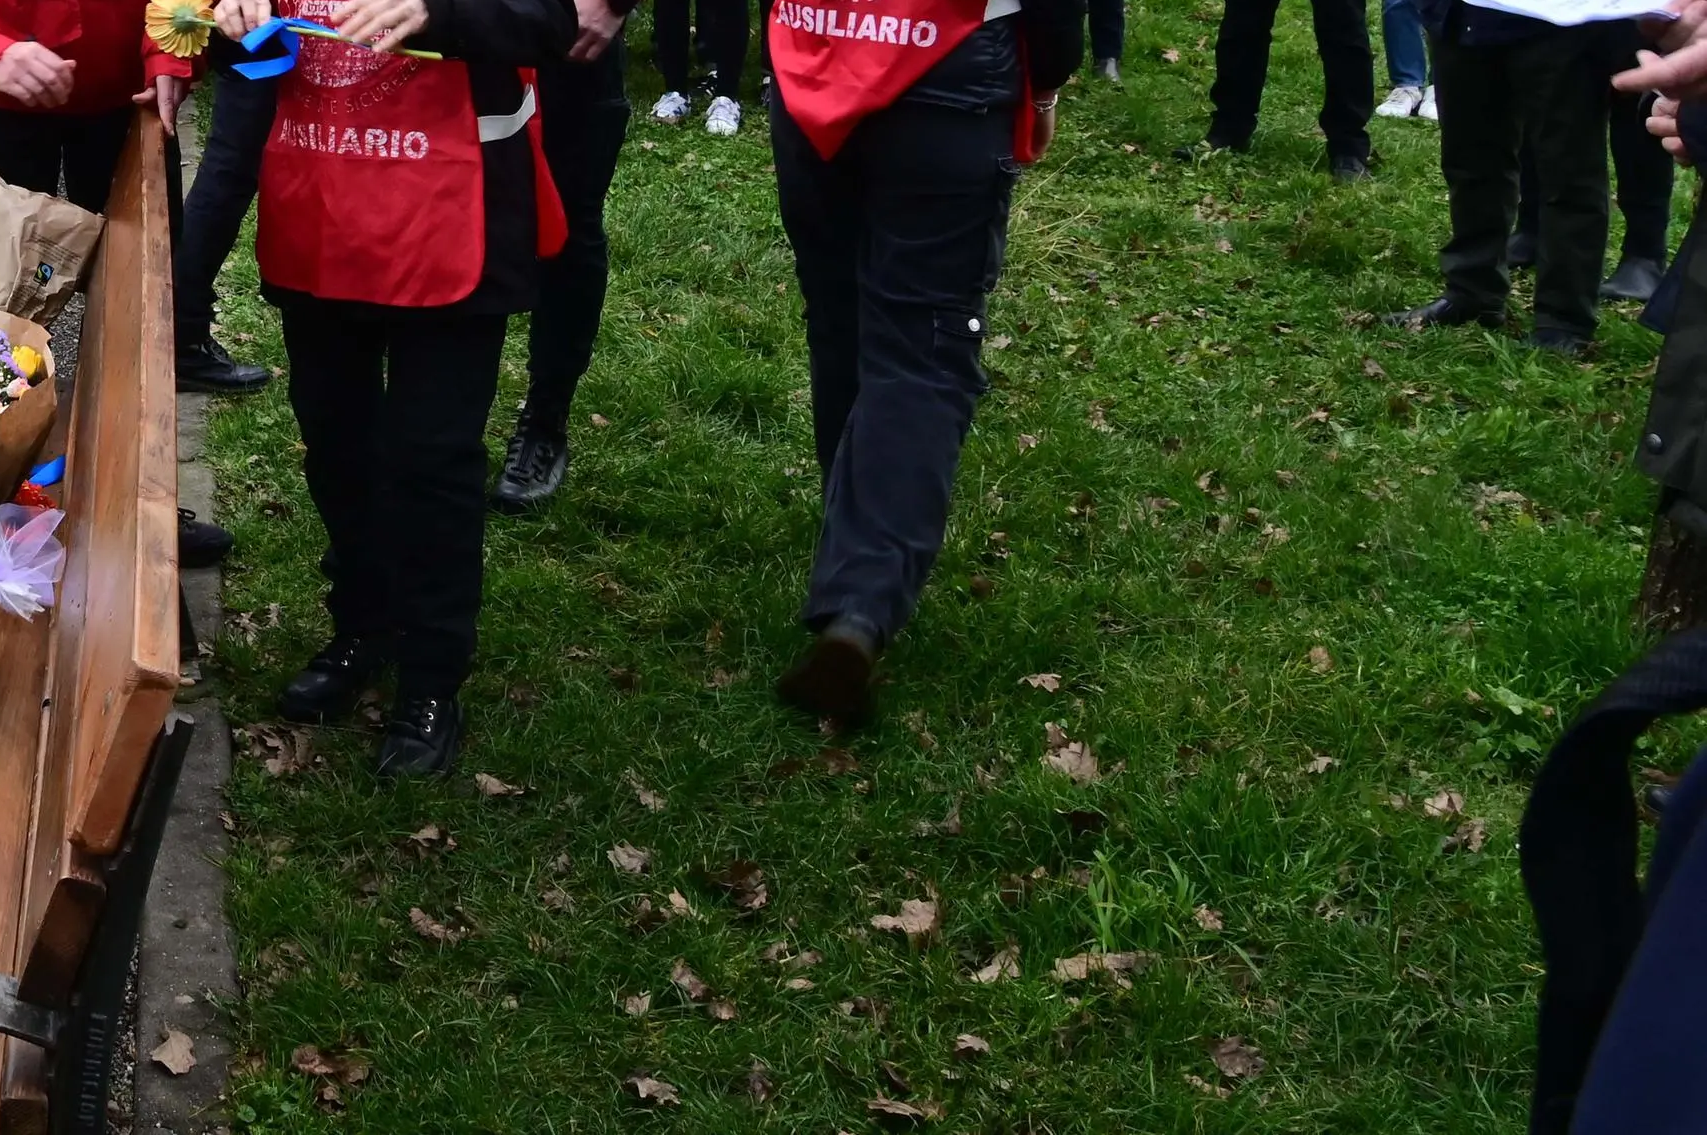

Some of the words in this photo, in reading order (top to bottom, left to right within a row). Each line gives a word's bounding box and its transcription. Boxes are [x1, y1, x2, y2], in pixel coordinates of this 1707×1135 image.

[775, 0, 938, 48] AUSILIARIO
[345, 56, 421, 114] SICUREZ
[278, 118, 429, 159] AUSILIARIO
